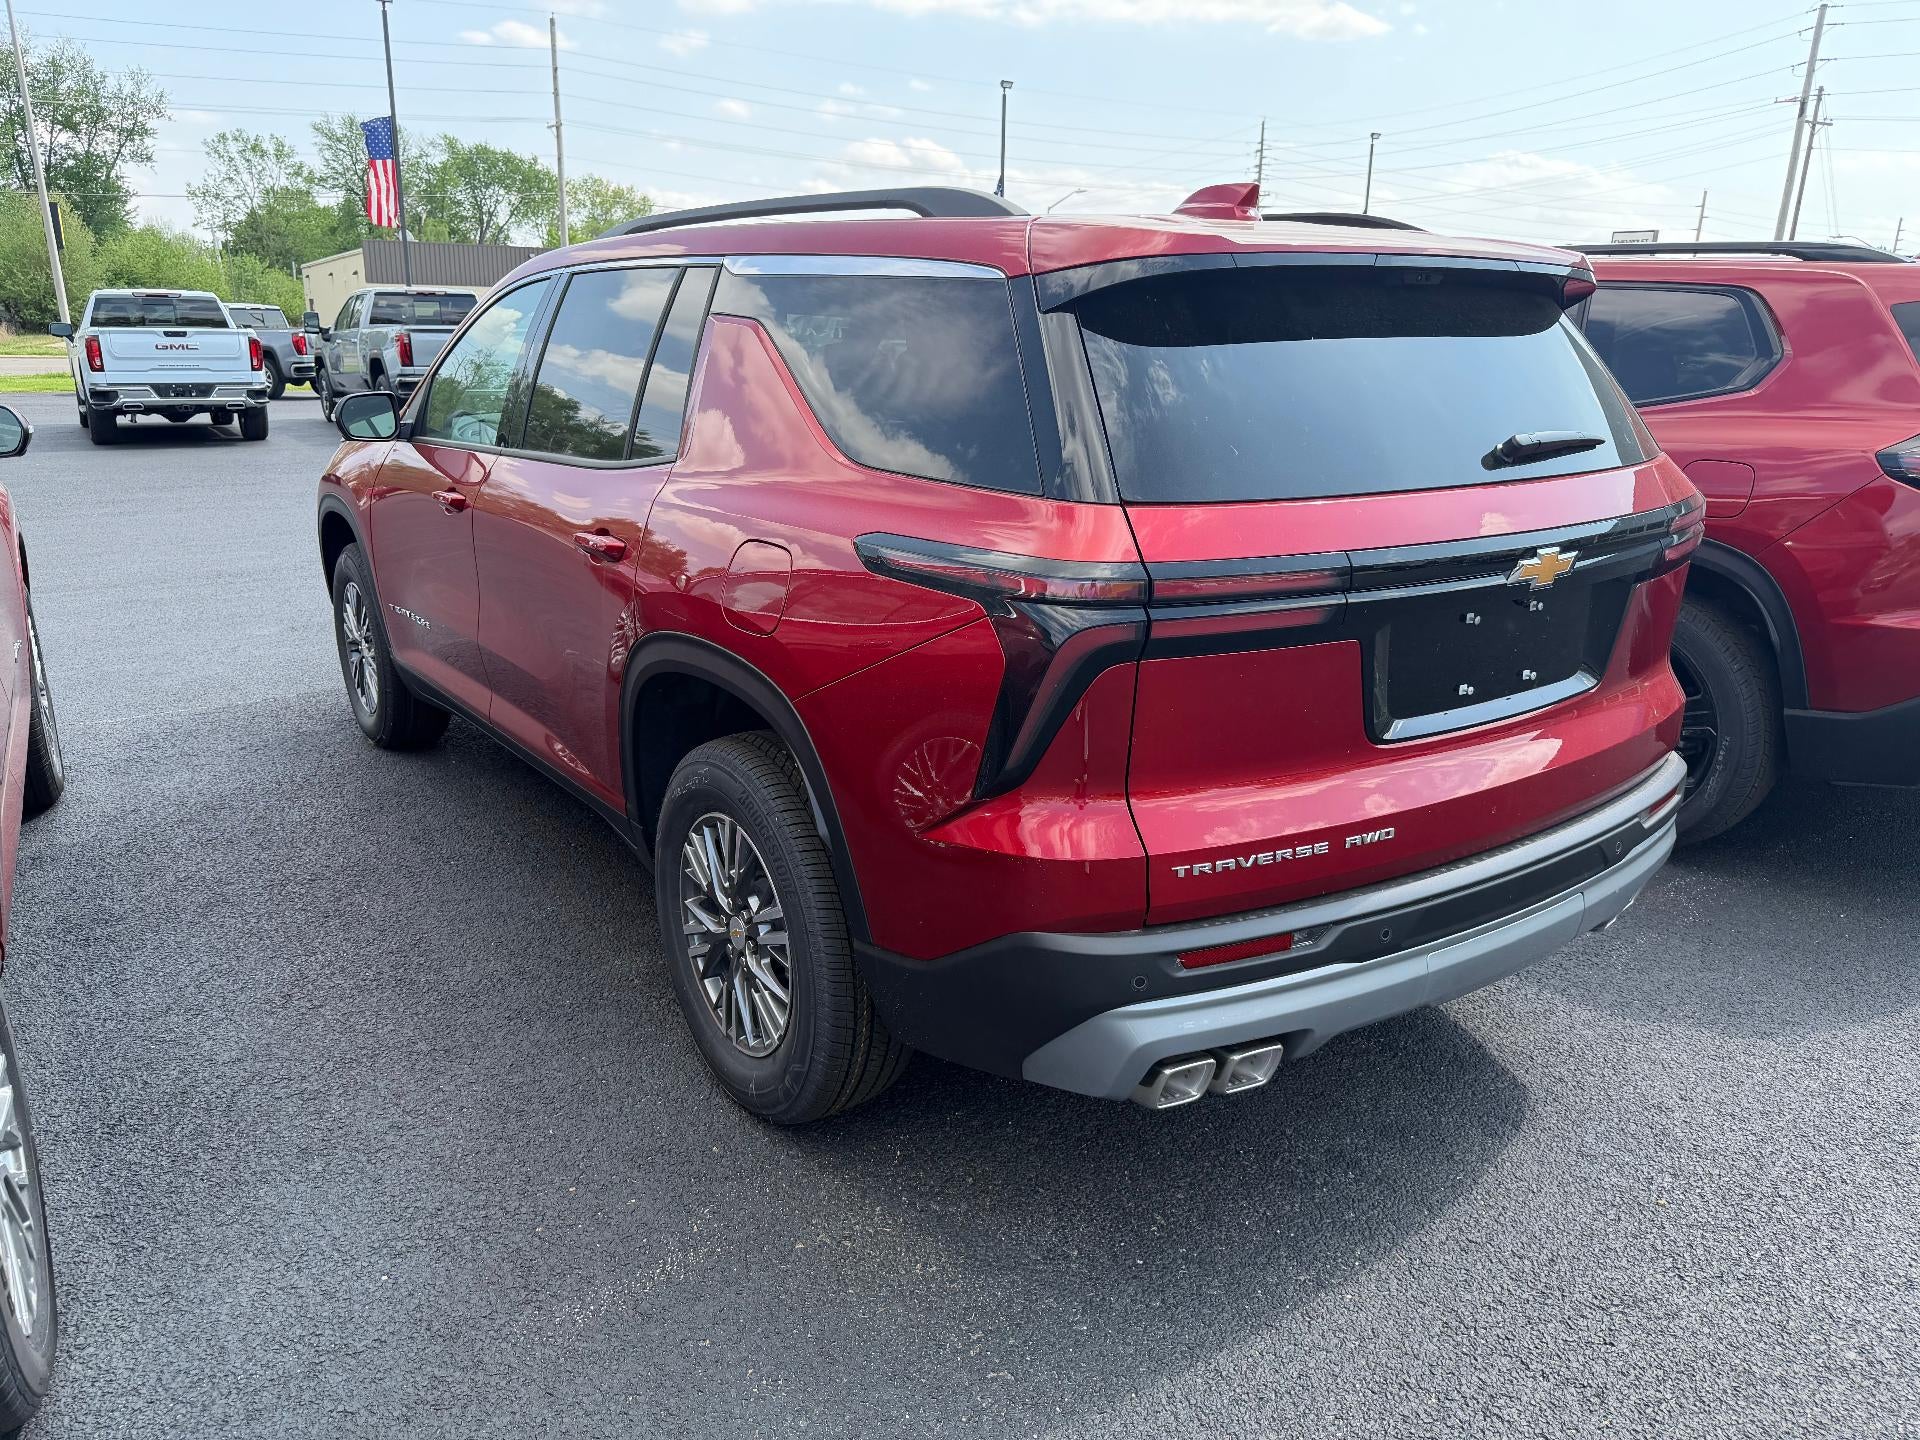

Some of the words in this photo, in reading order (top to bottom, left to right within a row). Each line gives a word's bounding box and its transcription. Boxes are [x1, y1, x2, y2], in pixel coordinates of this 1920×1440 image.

[155, 343, 200, 351] GMC
[1171, 841, 1329, 878] TRAVERSE
[1345, 827, 1395, 849] AWD
